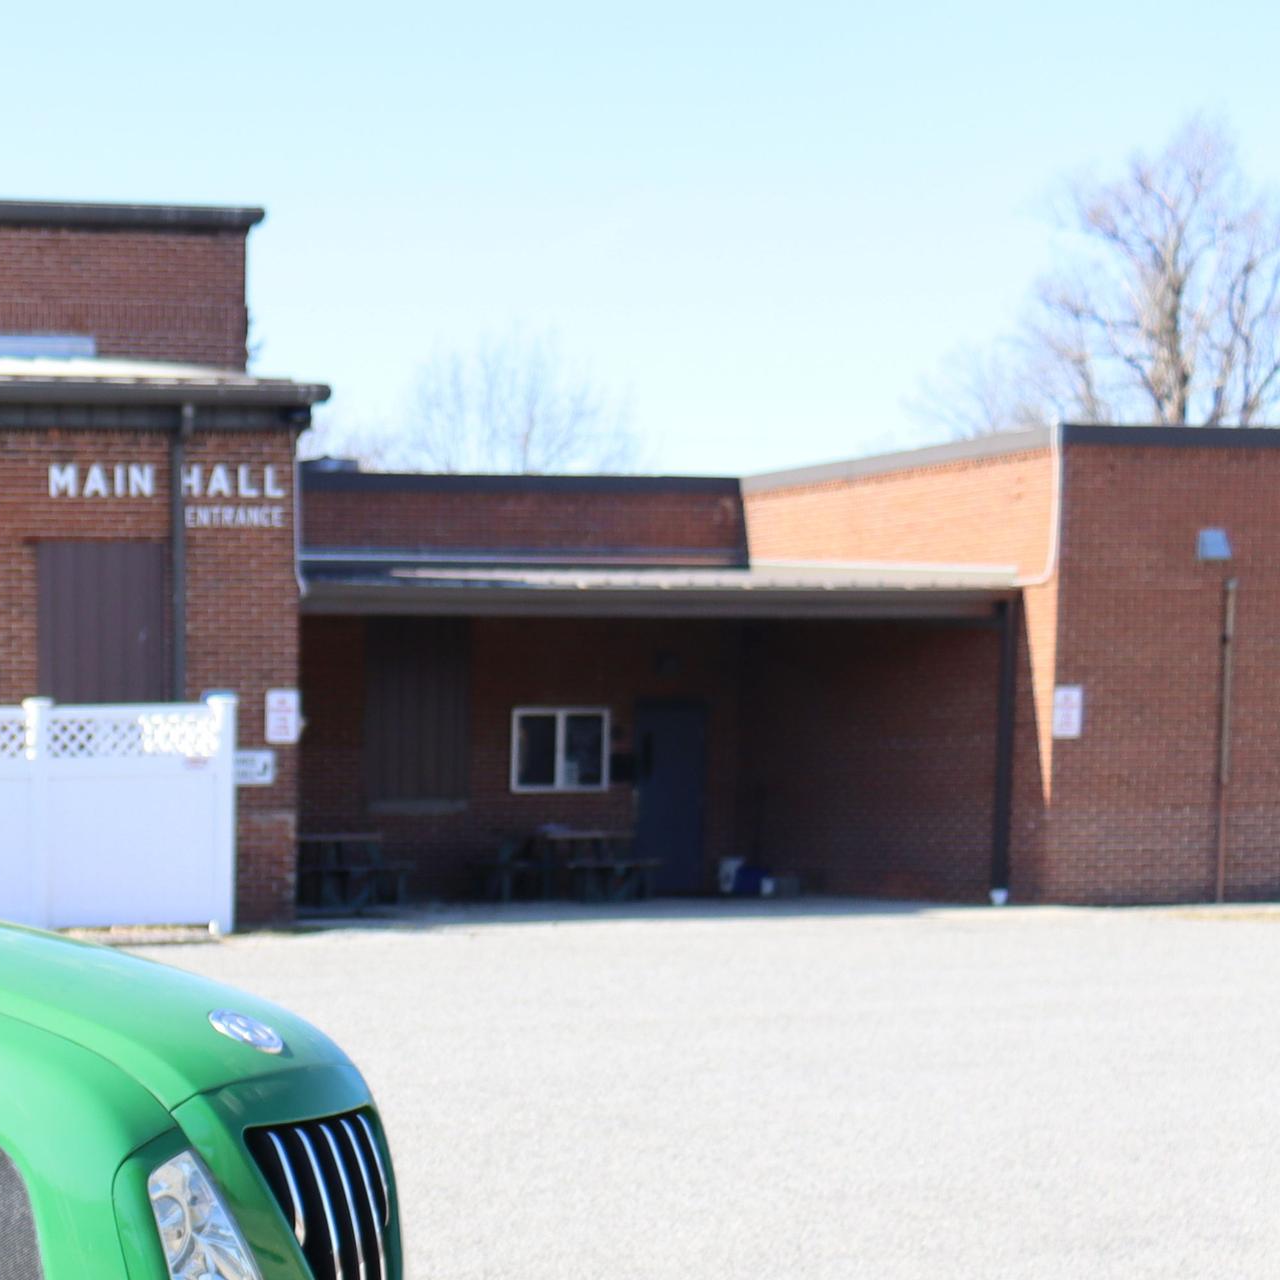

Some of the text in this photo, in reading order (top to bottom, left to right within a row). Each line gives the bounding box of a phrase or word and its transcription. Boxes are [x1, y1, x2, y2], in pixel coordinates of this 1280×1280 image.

[48, 463, 288, 498] MAIN HALL
[184, 505, 286, 528] ENTRANCE
